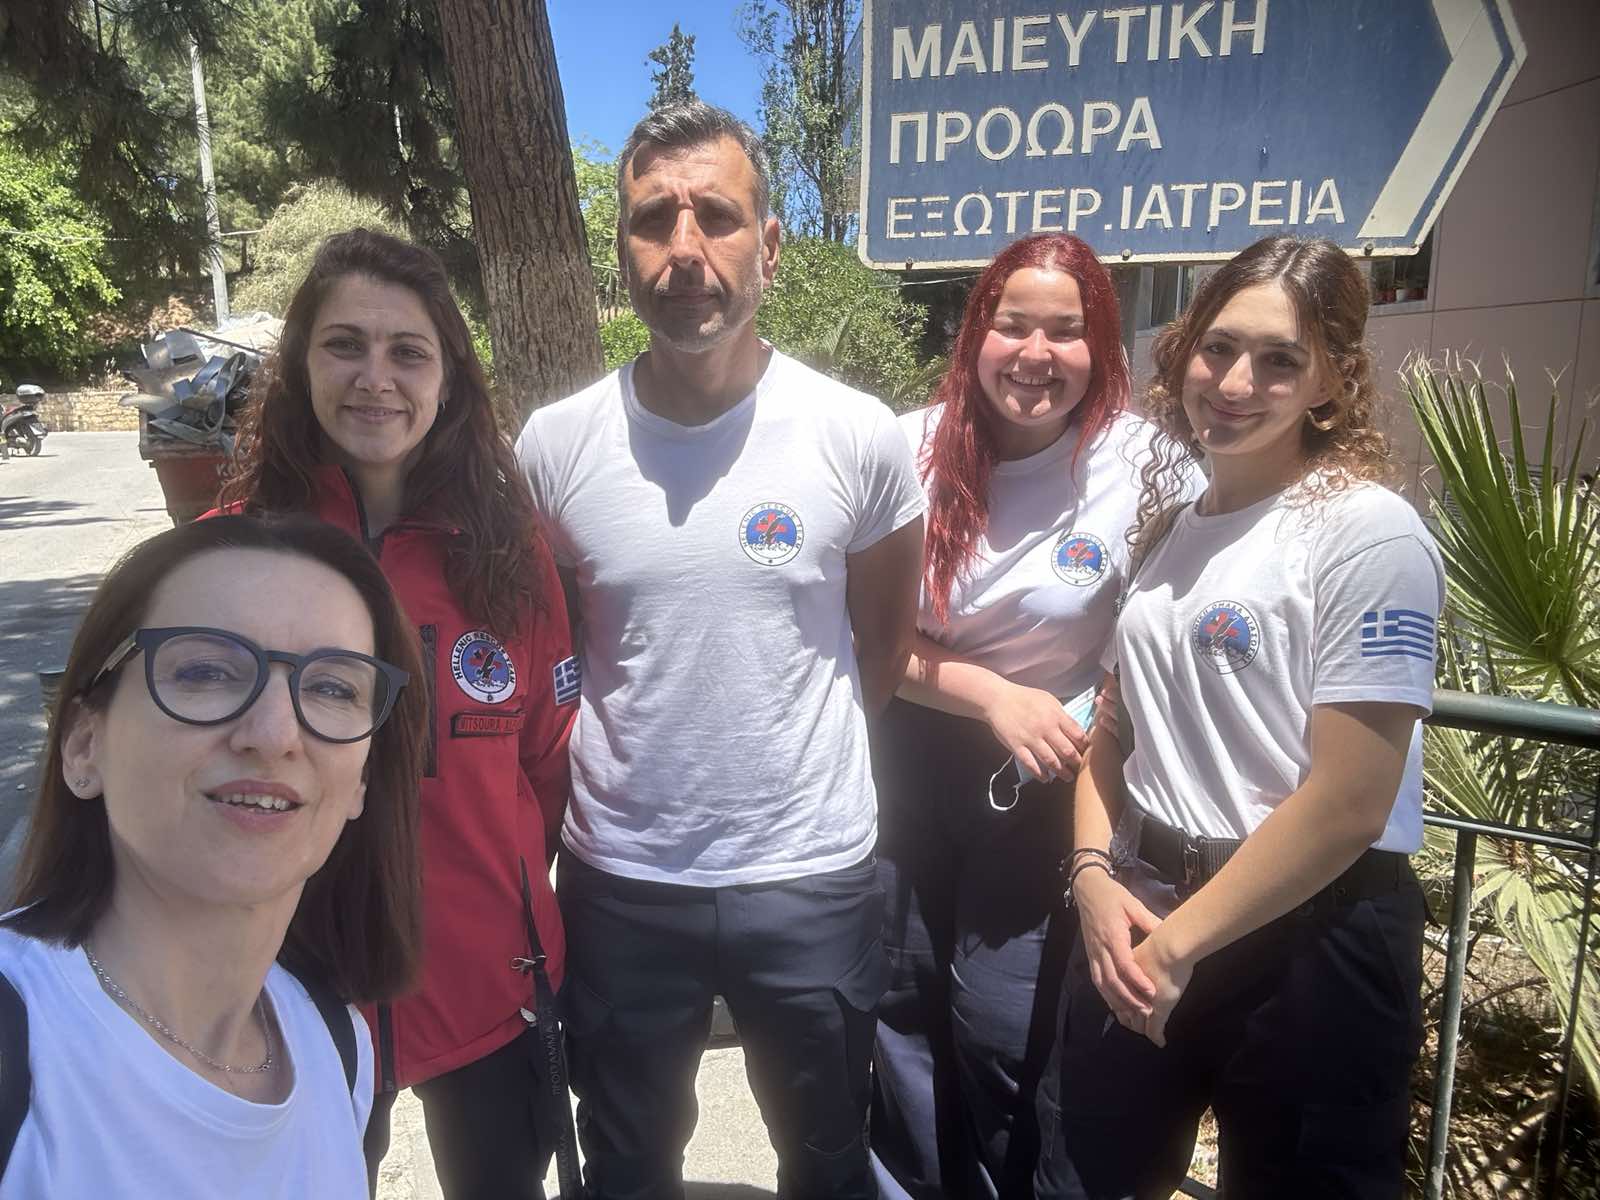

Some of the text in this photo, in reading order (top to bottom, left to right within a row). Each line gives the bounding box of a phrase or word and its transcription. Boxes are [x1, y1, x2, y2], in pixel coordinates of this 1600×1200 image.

[892, 0, 1267, 80] ΜΑΙΕΥΤΙΚΗ
[890, 97, 1163, 164] ΠΡΟΩΡΑ
[452, 634, 472, 680] HELLENIC
